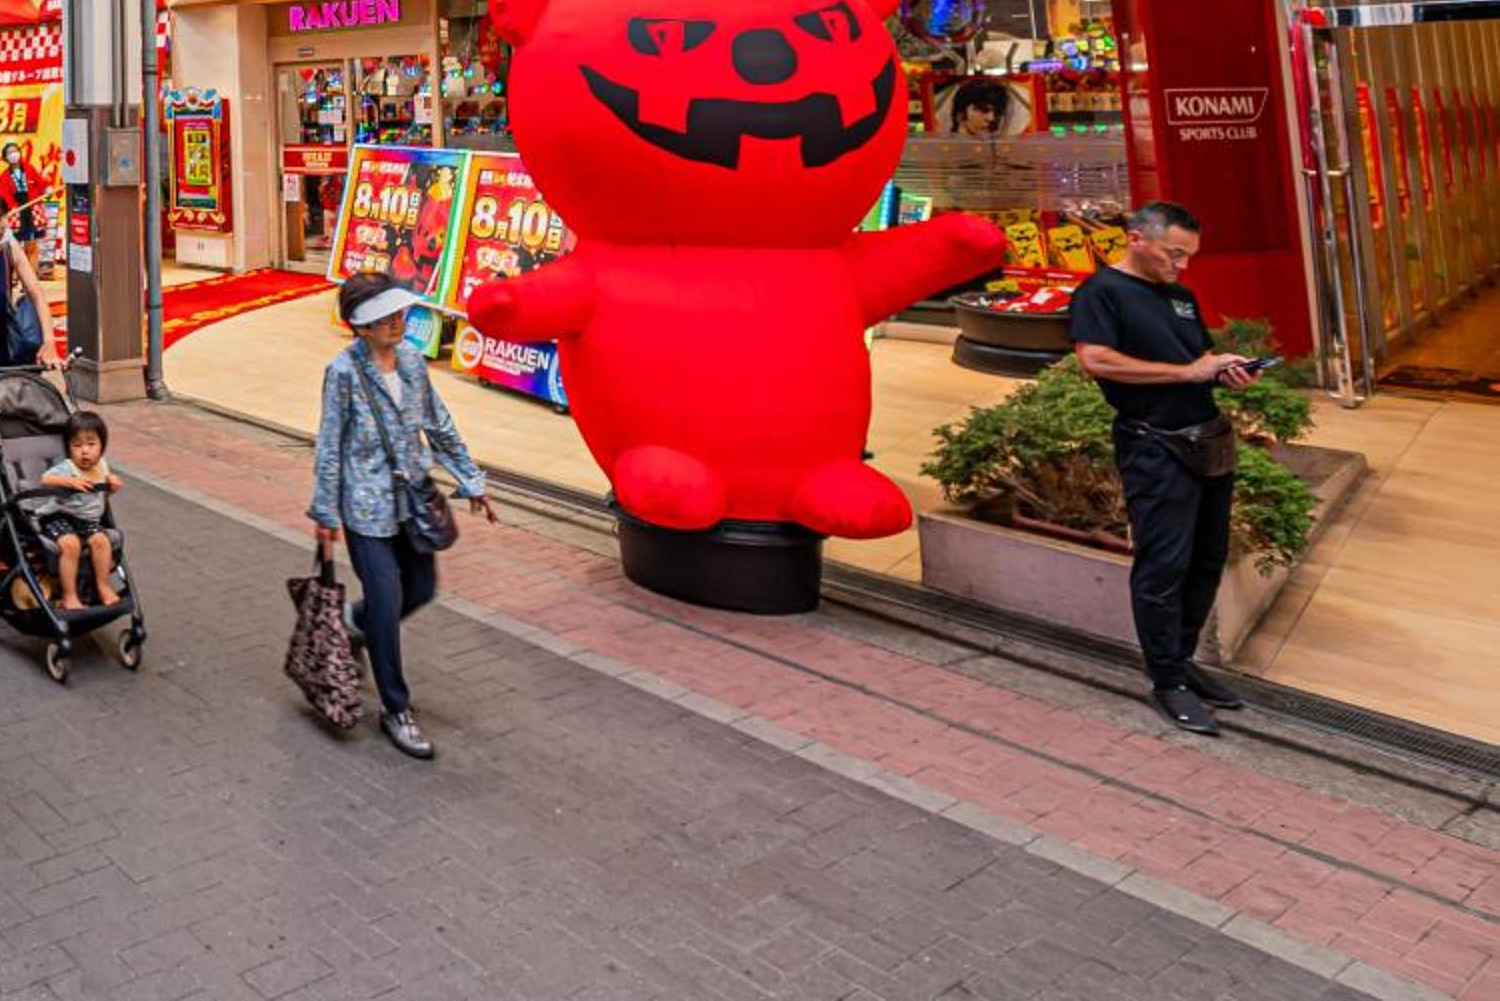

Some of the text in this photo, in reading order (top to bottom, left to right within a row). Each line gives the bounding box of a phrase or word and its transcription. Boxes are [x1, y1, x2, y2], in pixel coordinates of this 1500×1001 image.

[1175, 96, 1254, 117] KONAMI
[1179, 126, 1258, 141] SPORTS CLUB
[484, 337, 551, 370] RAKUEN
